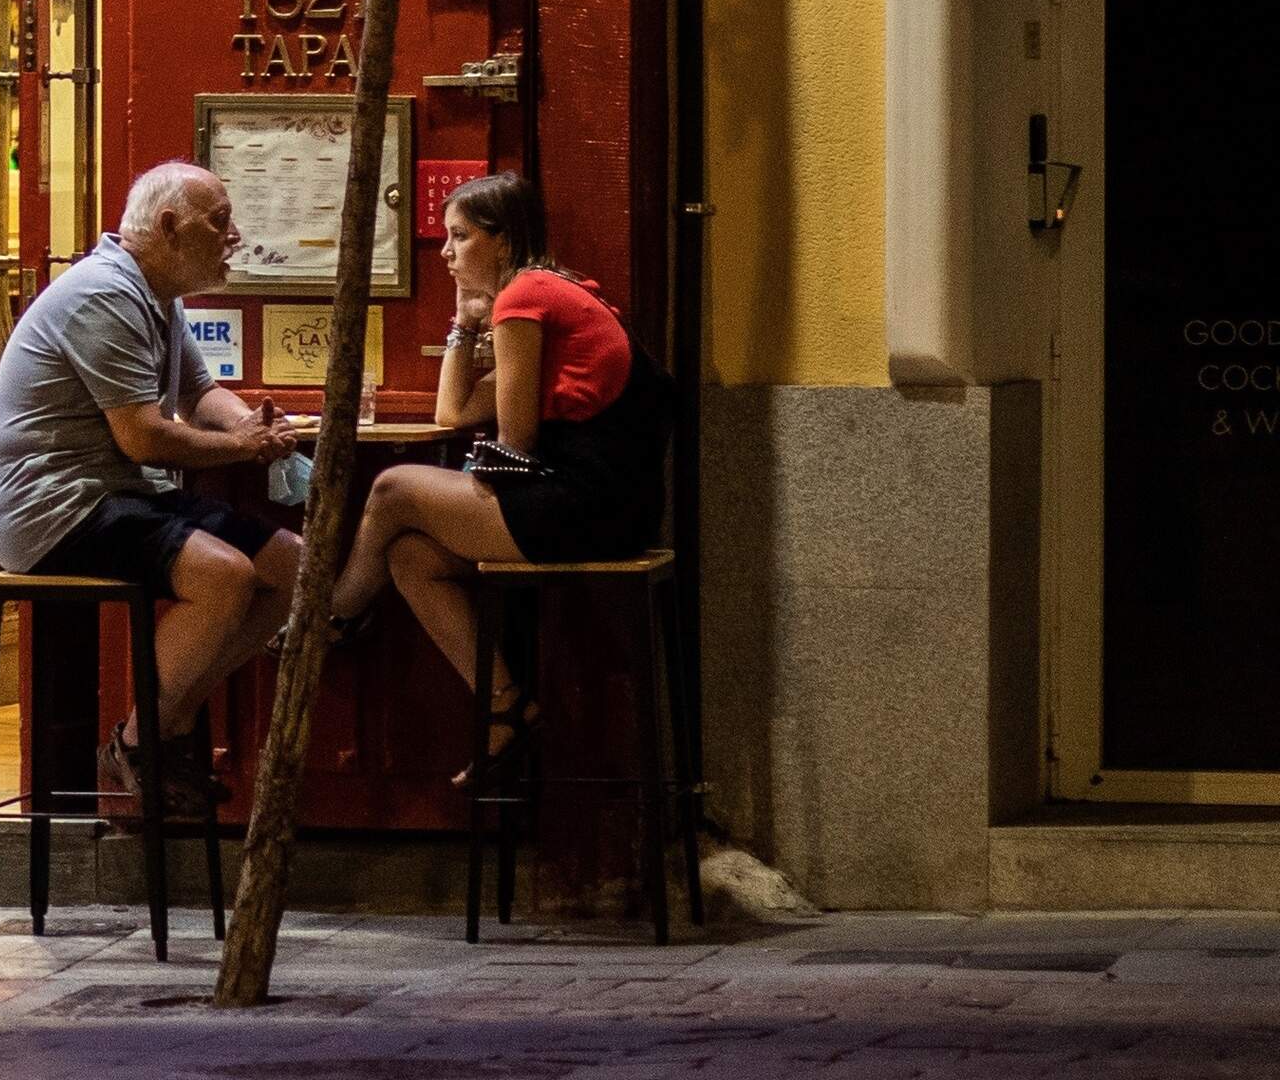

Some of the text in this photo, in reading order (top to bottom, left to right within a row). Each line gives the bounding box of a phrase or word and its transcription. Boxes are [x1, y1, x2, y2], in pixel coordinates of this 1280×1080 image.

[232, 33, 360, 77] TAPA
[189, 321, 232, 344] MER
[1197, 364, 1280, 391] COC
